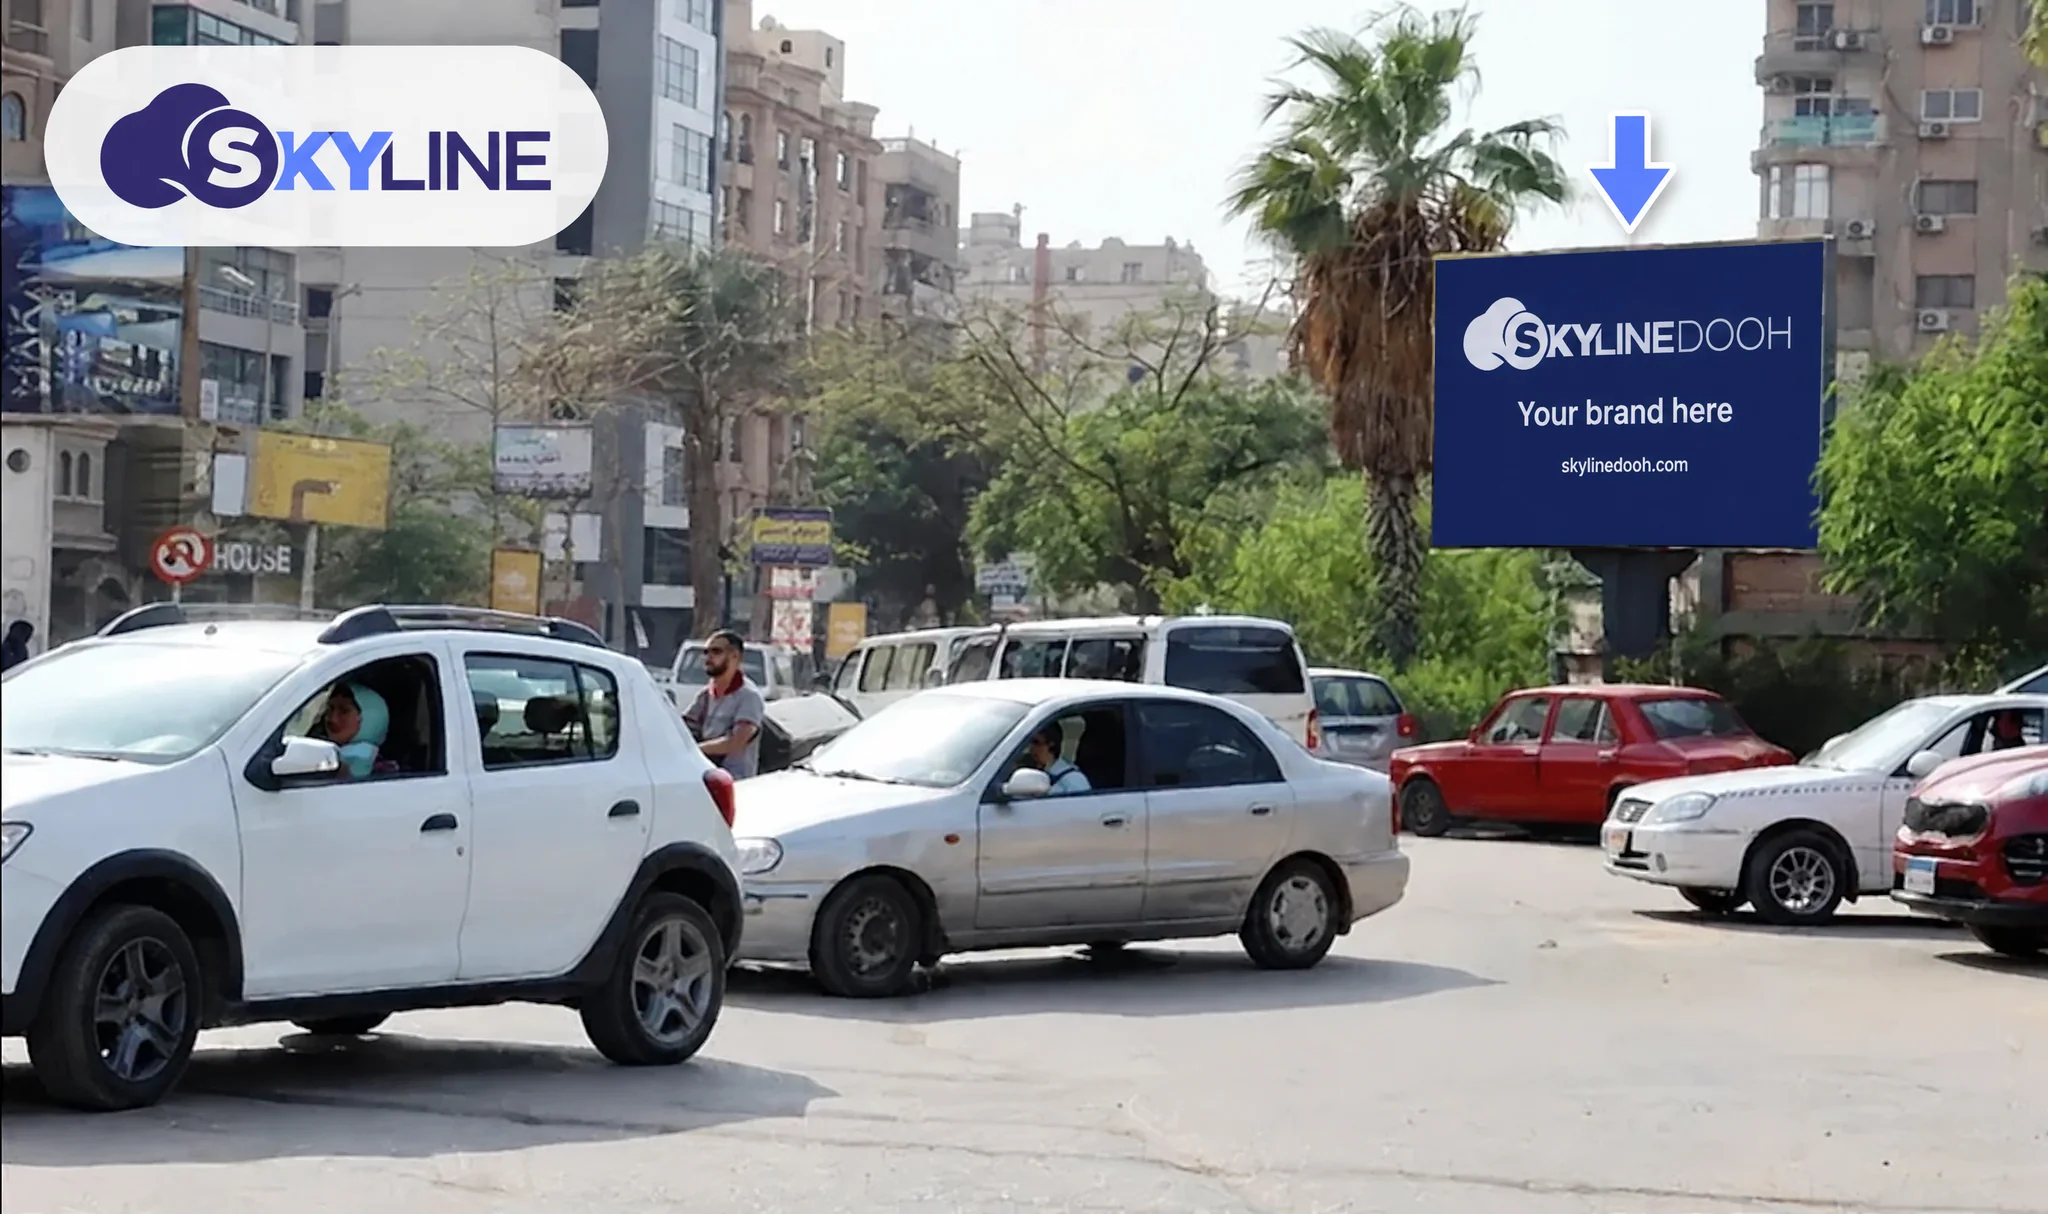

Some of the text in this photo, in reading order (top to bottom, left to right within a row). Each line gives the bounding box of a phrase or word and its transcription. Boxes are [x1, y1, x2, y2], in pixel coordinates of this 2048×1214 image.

[1517, 397, 1734, 427] Your brand here
[1561, 456, 1689, 477] skylinedooh.com
[213, 543, 292, 573] HOUSE
